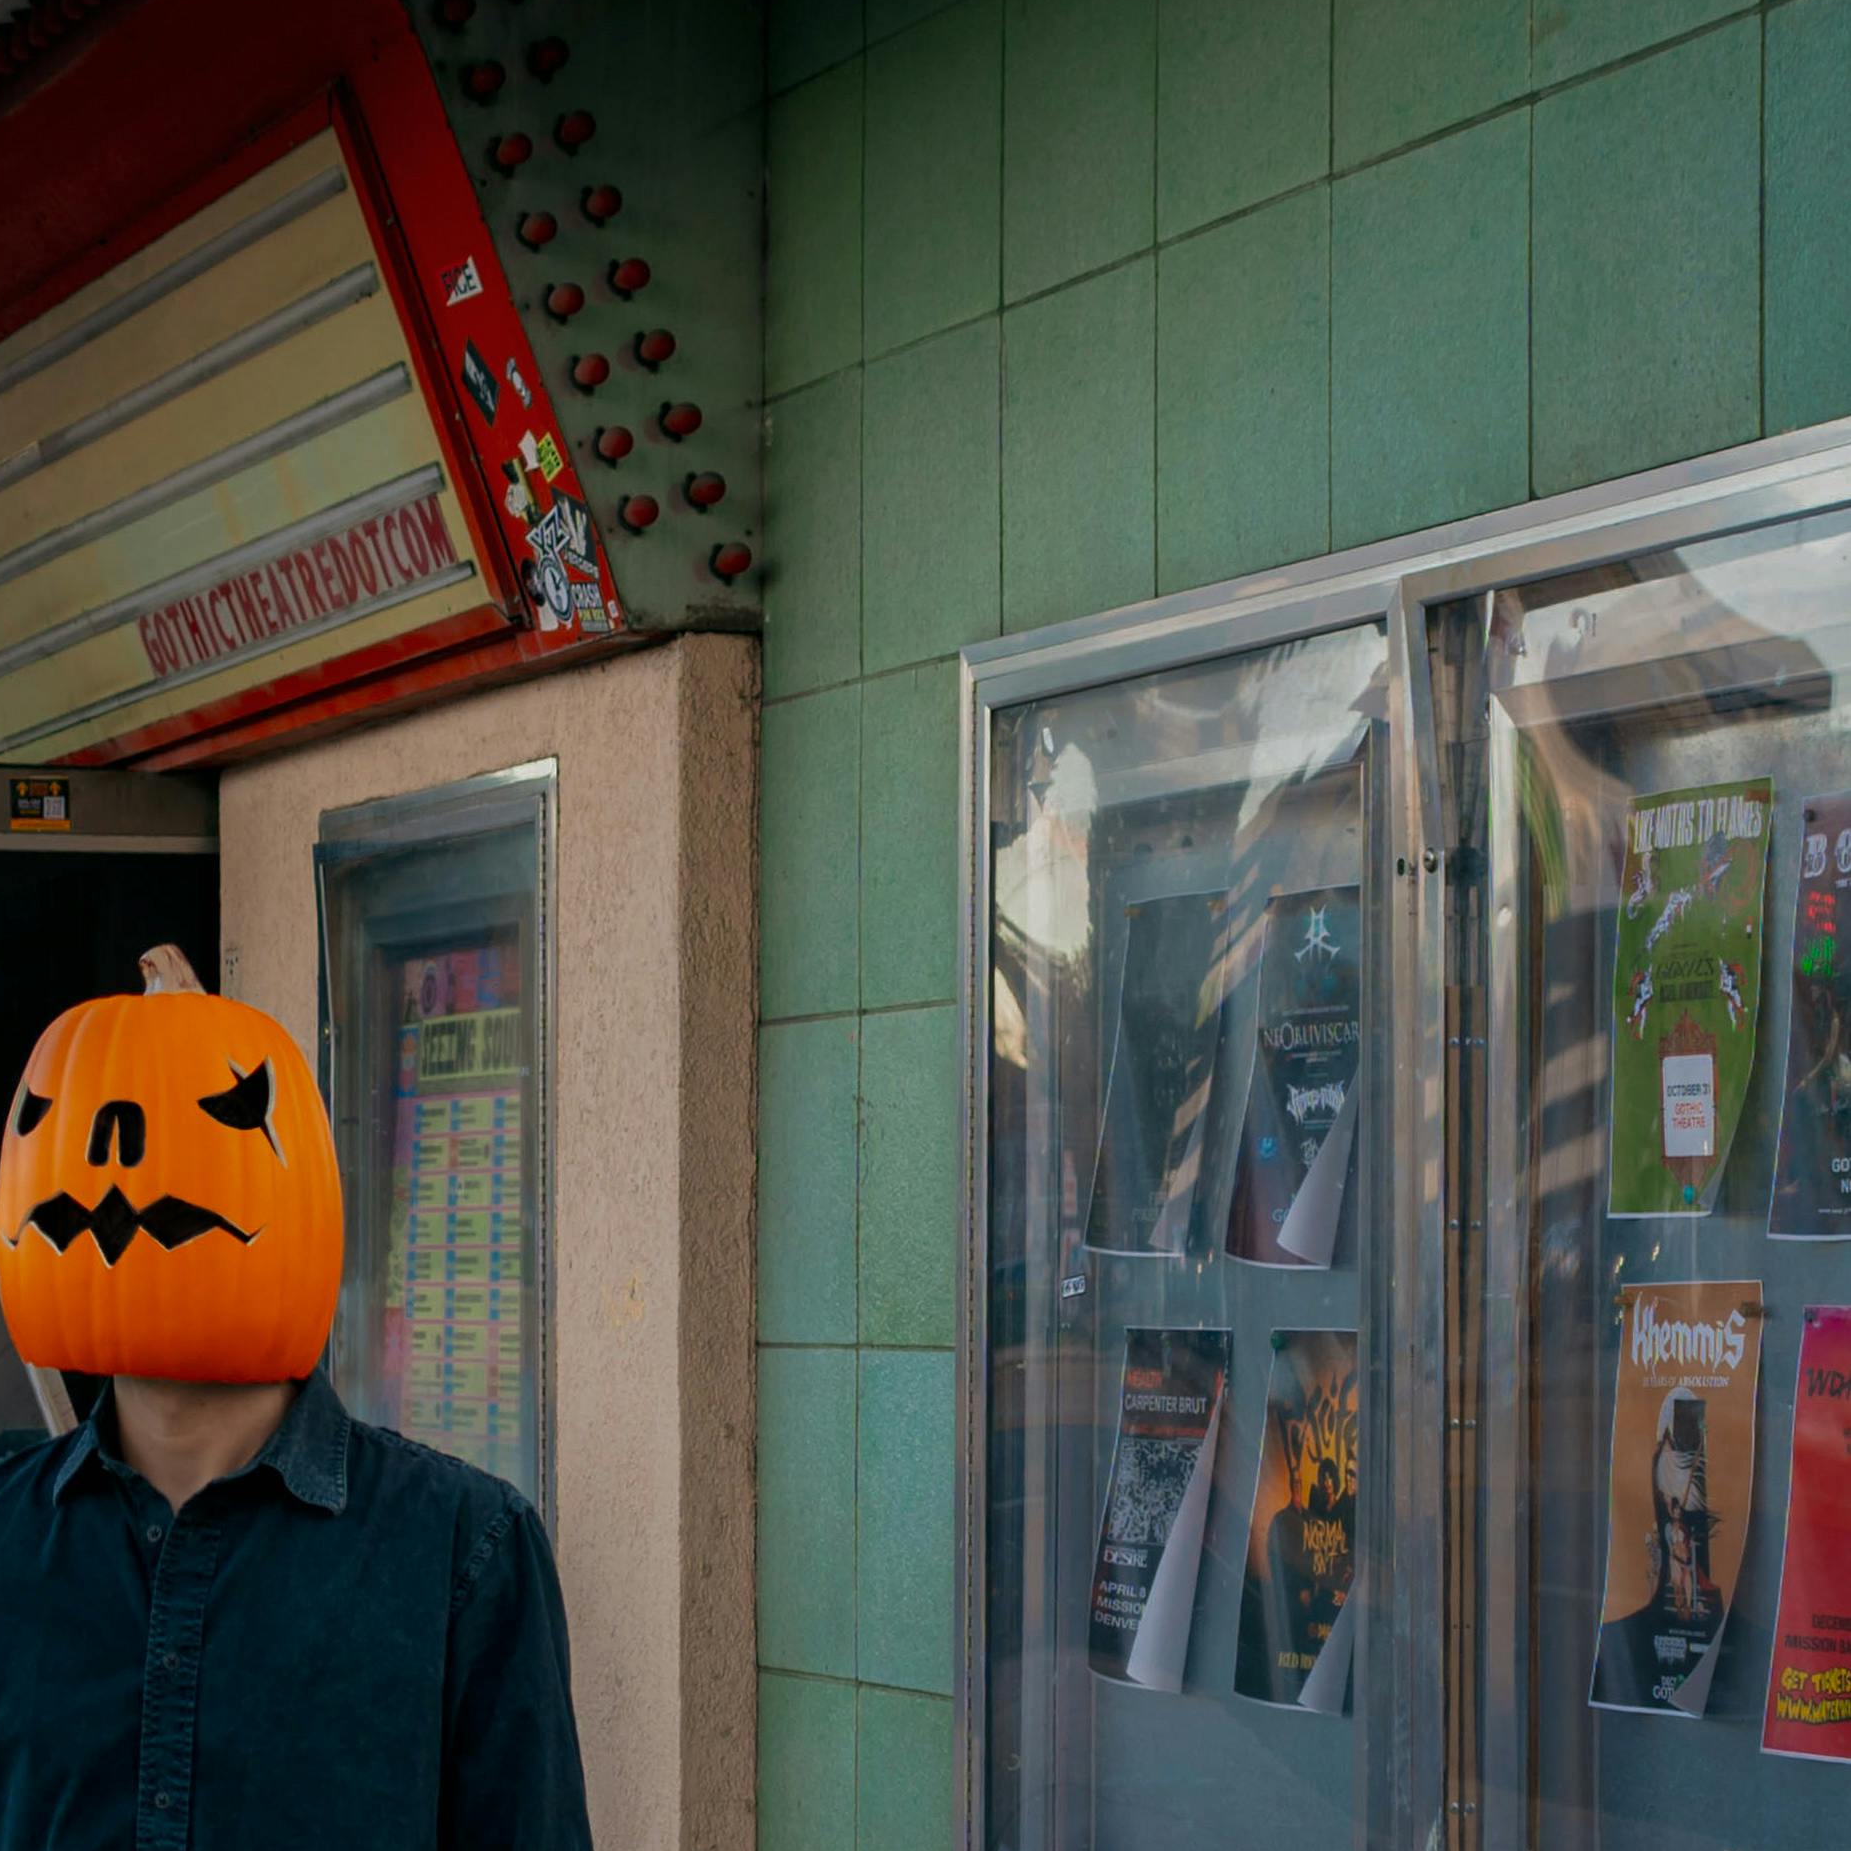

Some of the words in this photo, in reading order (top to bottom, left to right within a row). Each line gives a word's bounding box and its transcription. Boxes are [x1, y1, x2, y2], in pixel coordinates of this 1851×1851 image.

[137, 492, 459, 676] GOTHICTHEATREDOTCOM
[1655, 801, 1695, 850] MOTHS
[1698, 798, 1714, 845] TO
[1667, 1083, 1702, 1097] OCTOBER
[1675, 1102, 1704, 1115] GOTHIC
[1672, 1116, 1706, 1130] THEATRE
[1124, 1393, 1177, 1413] CARPENTER
[1178, 1395, 1207, 1415] BRUT
[1099, 1579, 1137, 1599] APRIL
[1094, 1609, 1139, 1630] DENVE
[1781, 1666, 1809, 1691] GET
